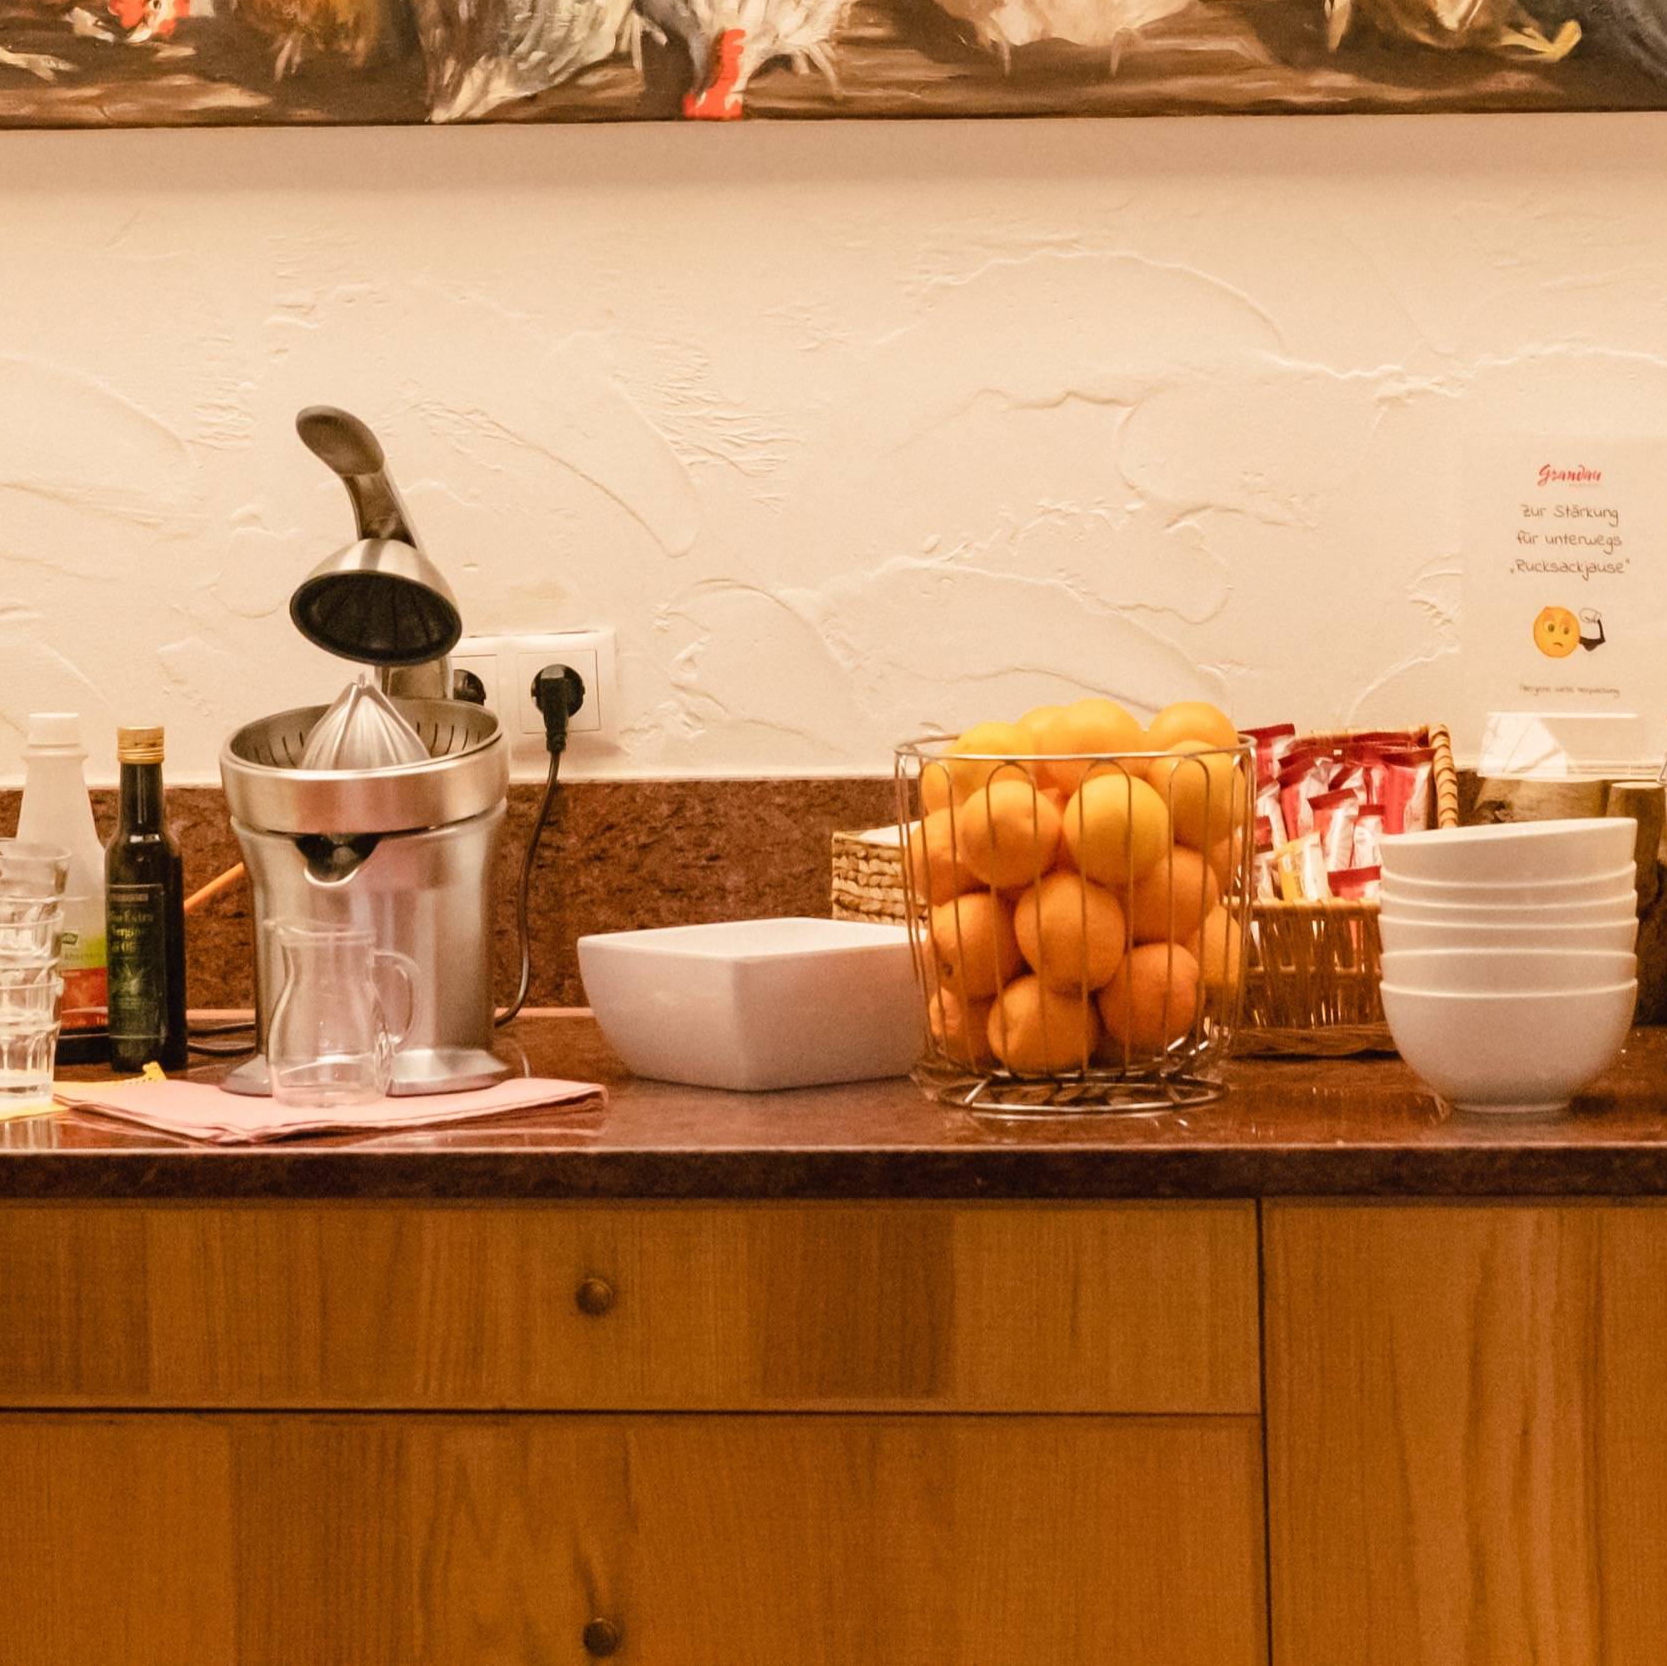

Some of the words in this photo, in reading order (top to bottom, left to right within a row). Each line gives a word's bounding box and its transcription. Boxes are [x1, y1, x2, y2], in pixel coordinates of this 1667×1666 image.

[1536, 463, 1602, 487] Grandau
[1553, 503, 1619, 528] Stärkung
[1517, 529, 1539, 546] für
[1545, 533, 1623, 555] unterwegs
